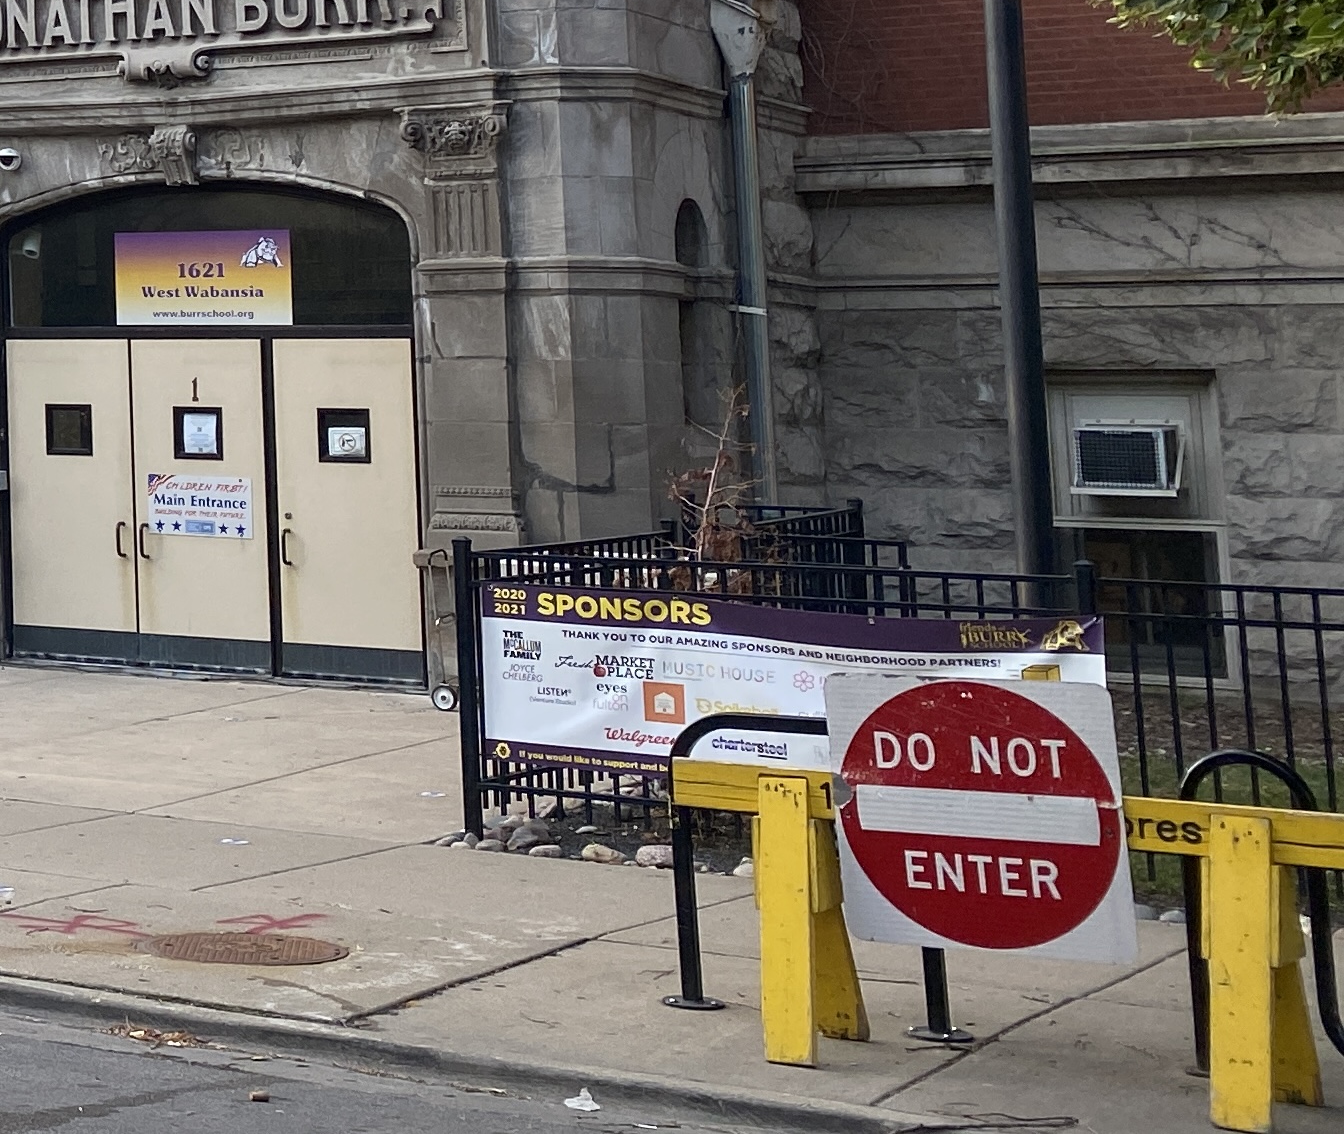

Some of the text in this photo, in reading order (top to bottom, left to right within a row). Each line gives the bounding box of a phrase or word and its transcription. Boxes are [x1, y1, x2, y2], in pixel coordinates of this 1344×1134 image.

[178, 263, 226, 279] 1621
[142, 285, 264, 298] West Wabansia
[153, 310, 254, 320] www.burrschool.org
[192, 377, 199, 402] 1
[154, 493, 247, 510] Main Entrance
[493, 588, 527, 601] 2020
[494, 602, 527, 615] 2021
[536, 593, 712, 626] SPONSORS
[502, 630, 523, 639] THE
[503, 650, 542, 660] FAMILY
[561, 629, 1001, 667] THANK YOU TO OUR AMAZING SPONSORS AND NEIGHBORHOOD PARTNERS!
[509, 663, 535, 674] JOYCE
[595, 655, 655, 669] MARKET
[502, 671, 543, 683] CHELBERG
[607, 667, 654, 680] PLACE
[662, 661, 776, 684] MUSIC HOUSE
[596, 683, 628, 695] eyes
[592, 698, 629, 712] fulton
[612, 694, 628, 702] on
[604, 727, 676, 748] Walgree
[527, 752, 544, 760] you
[545, 754, 572, 763] would
[574, 756, 590, 764] like
[592, 757, 602, 766] to
[603, 759, 639, 770] support
[640, 762, 658, 772] and
[872, 730, 1067, 780] DO NOT
[903, 849, 1063, 901] ENTER
